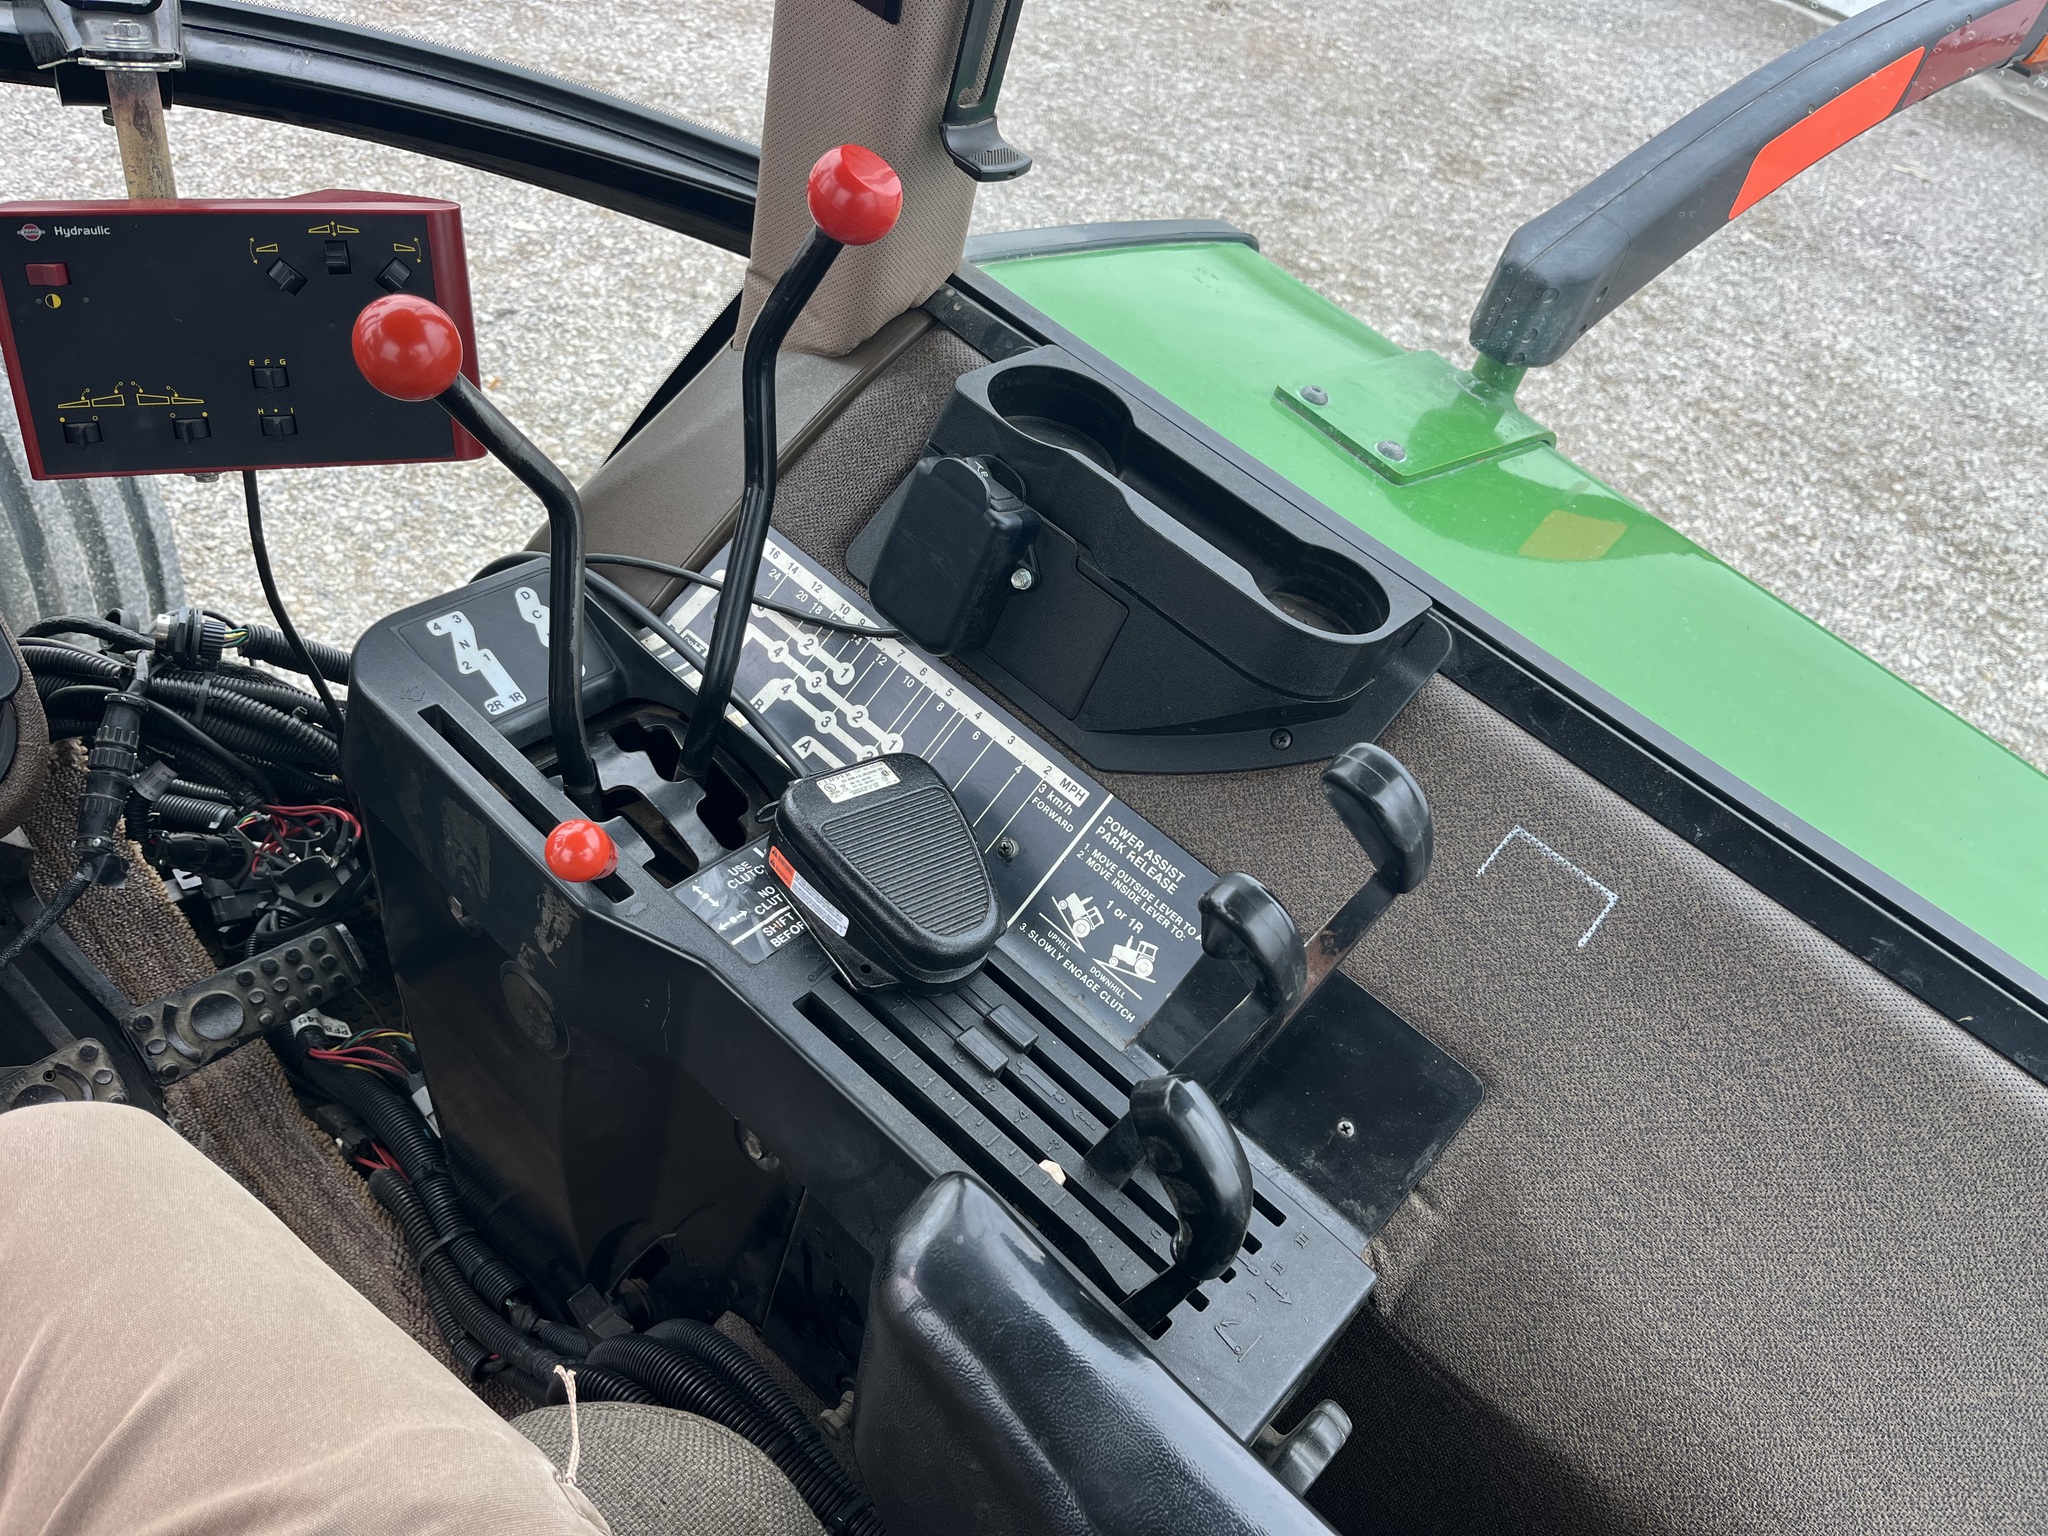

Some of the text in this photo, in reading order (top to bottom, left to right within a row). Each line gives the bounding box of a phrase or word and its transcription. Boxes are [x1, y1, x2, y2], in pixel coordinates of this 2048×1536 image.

[54, 225, 111, 238] Hydraulic
[280, 358, 286, 366] G
[520, 591, 531, 600] D
[433, 614, 462, 631] 4 3
[532, 610, 542, 619] C
[459, 639, 470, 649] N
[462, 653, 491, 670] 2 1
[803, 638, 850, 678] 2 1
[769, 547, 781, 560] 16
[787, 562, 800, 575] 14
[811, 581, 823, 594] 12
[838, 603, 851, 615] 10
[897, 649, 906, 658] 7
[919, 667, 928, 676] 6
[945, 687, 954, 697] 5
[974, 711, 983, 720] 4
[1007, 735, 1016, 745] 3
[1043, 765, 1053, 775] 2
[1059, 777, 1086, 801] MPH
[486, 691, 524, 712] 2R 1R
[768, 568, 780, 581] 24
[795, 590, 808, 603] 20
[811, 602, 823, 614] 18
[875, 653, 888, 667] 12
[902, 675, 915, 688] 10
[936, 702, 945, 711] 8
[972, 731, 981, 741] 6
[1015, 765, 1023, 774] 4
[1038, 783, 1047, 793] 3
[1047, 790, 1073, 816] km/h
[773, 646, 898, 751] 4 3 2 1
[752, 684, 873, 760] B 4 3 2
[798, 740, 812, 753] A
[1031, 796, 1074, 833] FORWARD
[1095, 826, 1178, 895] PARK RELEASE
[1103, 815, 1186, 883] POWER ASSIST
[727, 861, 752, 876] USE
[727, 864, 765, 889] CLUTC
[757, 886, 775, 898] NO
[1076, 850, 1186, 942] 2. MOVE INSIDE LEVER TO:
[1084, 843, 1091, 853] 1.
[1091, 849, 1119, 873] MOVE
[1116, 869, 1156, 903] OUTSIDE
[1153, 898, 1183, 926] LEVER
[1183, 922, 1197, 936] TO
[754, 893, 783, 915] CLUT
[762, 911, 795, 937] SHIFT
[1106, 900, 1144, 934] 1 or 1R
[1047, 930, 1071, 954] UPHILL
[1019, 922, 1136, 1023] 3. SLOWLY ENGAGE CLUTCH
[1089, 966, 1126, 1000] DOWNHILL
